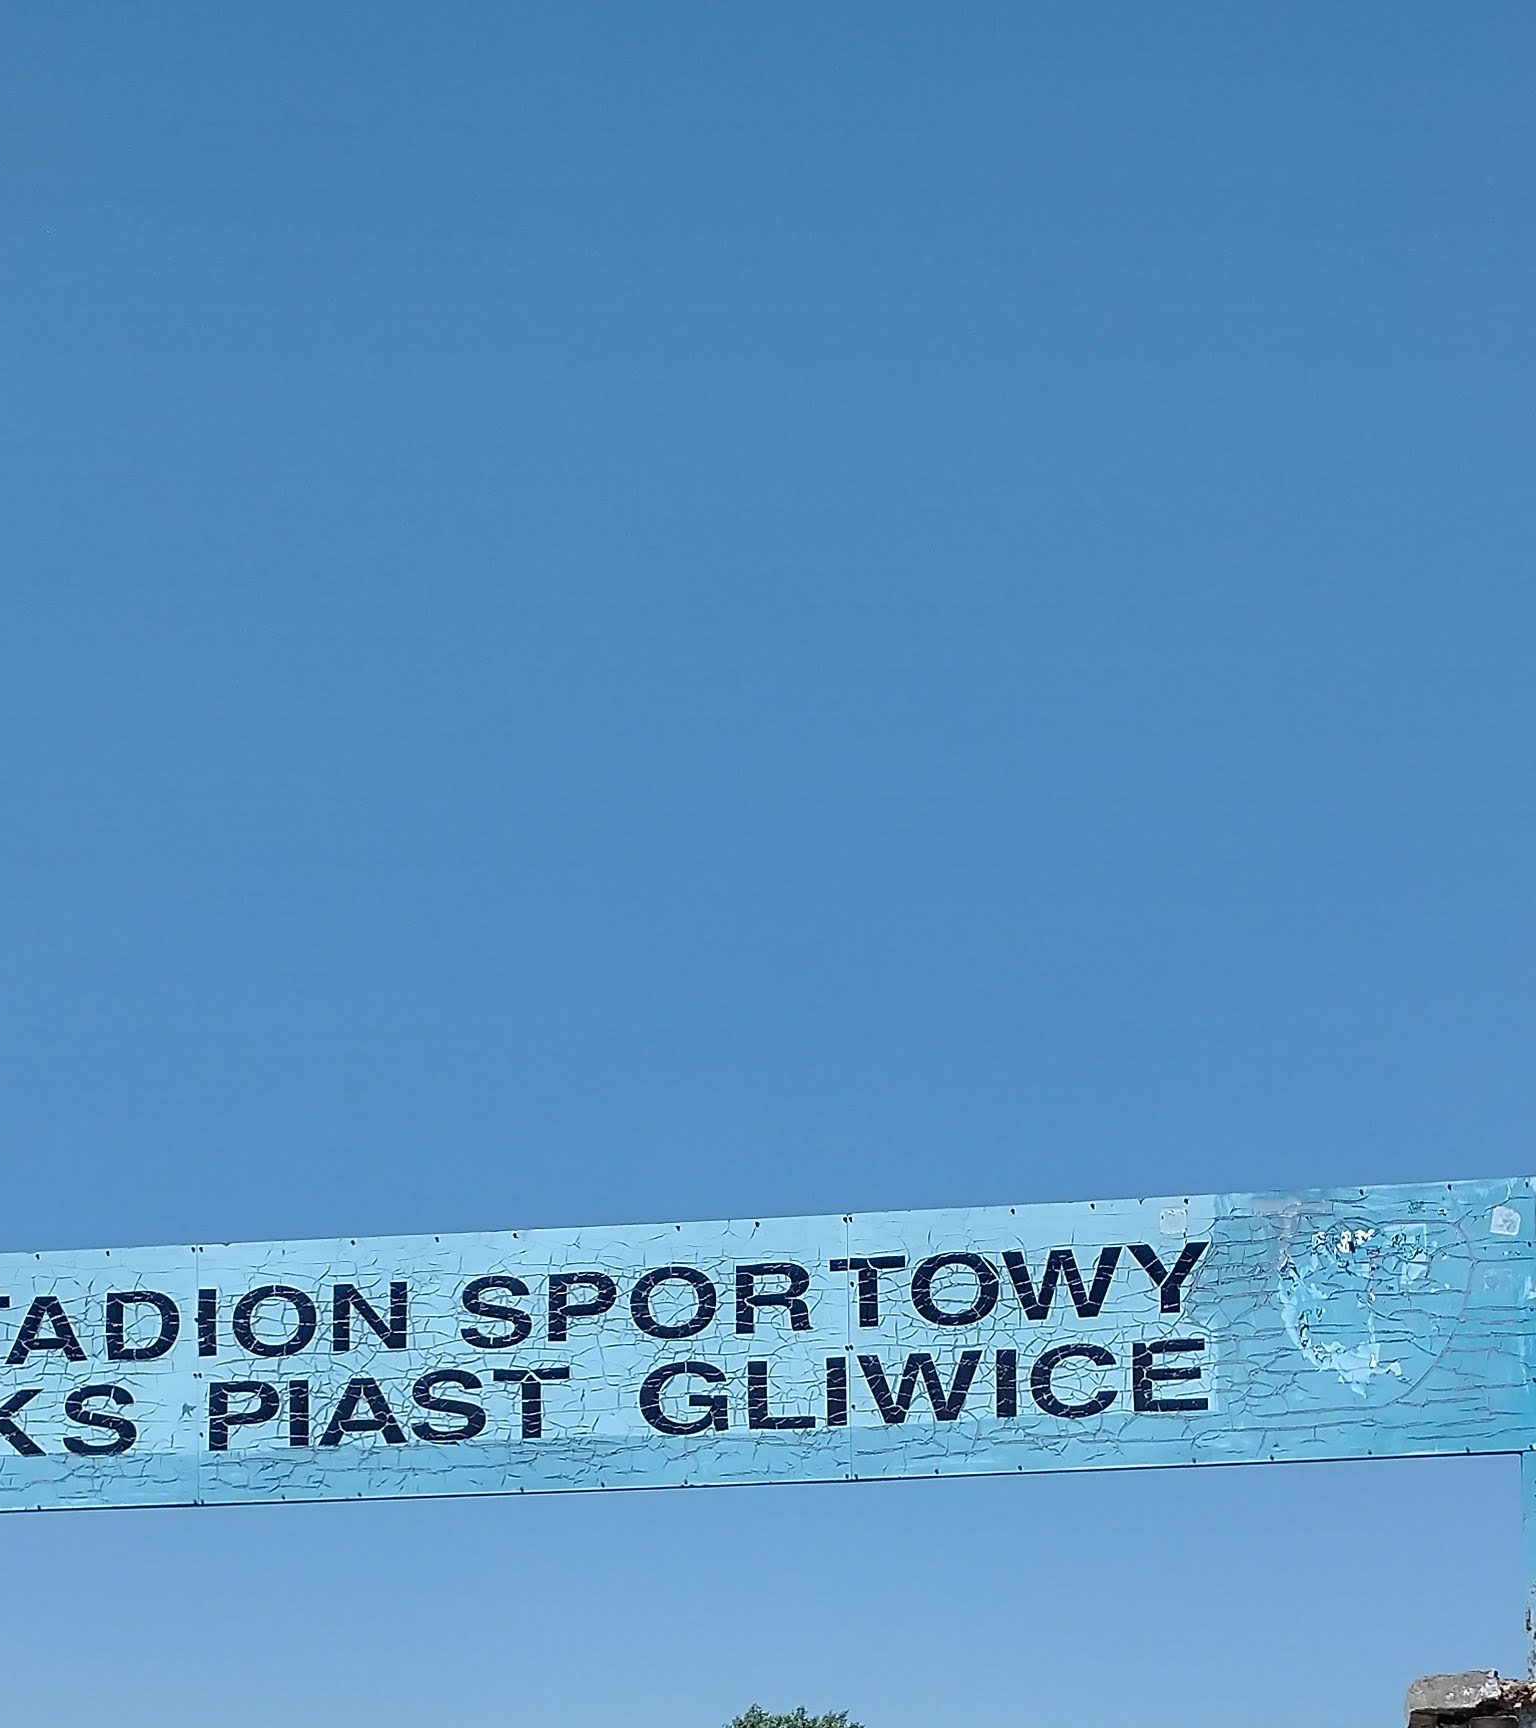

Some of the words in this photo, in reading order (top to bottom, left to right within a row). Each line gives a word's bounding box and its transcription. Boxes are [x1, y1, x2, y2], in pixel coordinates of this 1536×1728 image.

[460, 1240, 1211, 1350] SPORTOWY
[208, 1366, 571, 1452] PIAST
[638, 1337, 1210, 1437] GLIWICE
